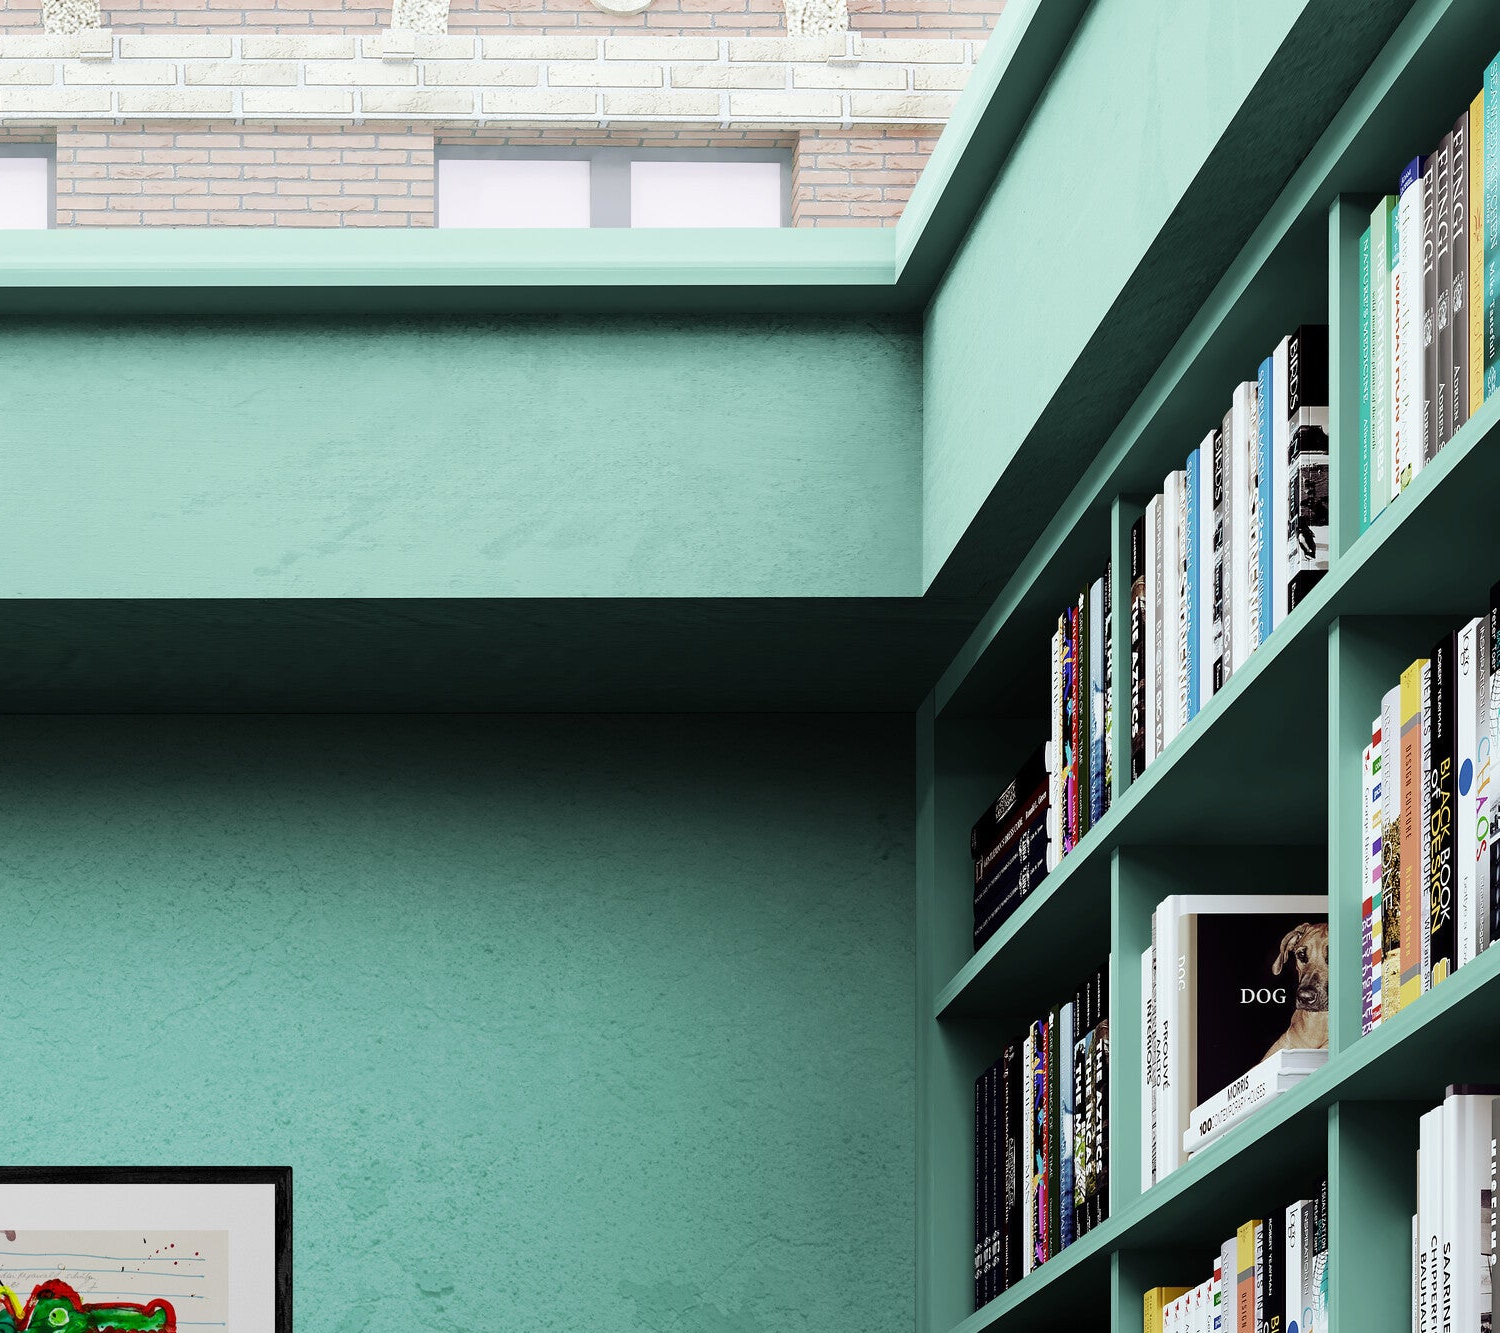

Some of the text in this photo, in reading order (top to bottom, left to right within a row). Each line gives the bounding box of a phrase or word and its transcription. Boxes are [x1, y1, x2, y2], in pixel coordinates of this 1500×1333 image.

[1438, 146, 1448, 260] FUNGI
[1453, 126, 1464, 242] FUNGI
[1423, 165, 1434, 278] FUNGI
[1288, 338, 1299, 410] BIRDS
[1214, 432, 1222, 500] BIRDS
[1131, 597, 1139, 738] THE AZTECS
[1460, 628, 1472, 676] logo
[1477, 737, 1490, 862] CHAOS
[1383, 838, 1393, 911] ONE
[1440, 756, 1451, 926] BLACK BOOK
[1240, 988, 1286, 1004] DOG
[1227, 1075, 1250, 1102] MORRIS
[1288, 1208, 1298, 1248] logo
